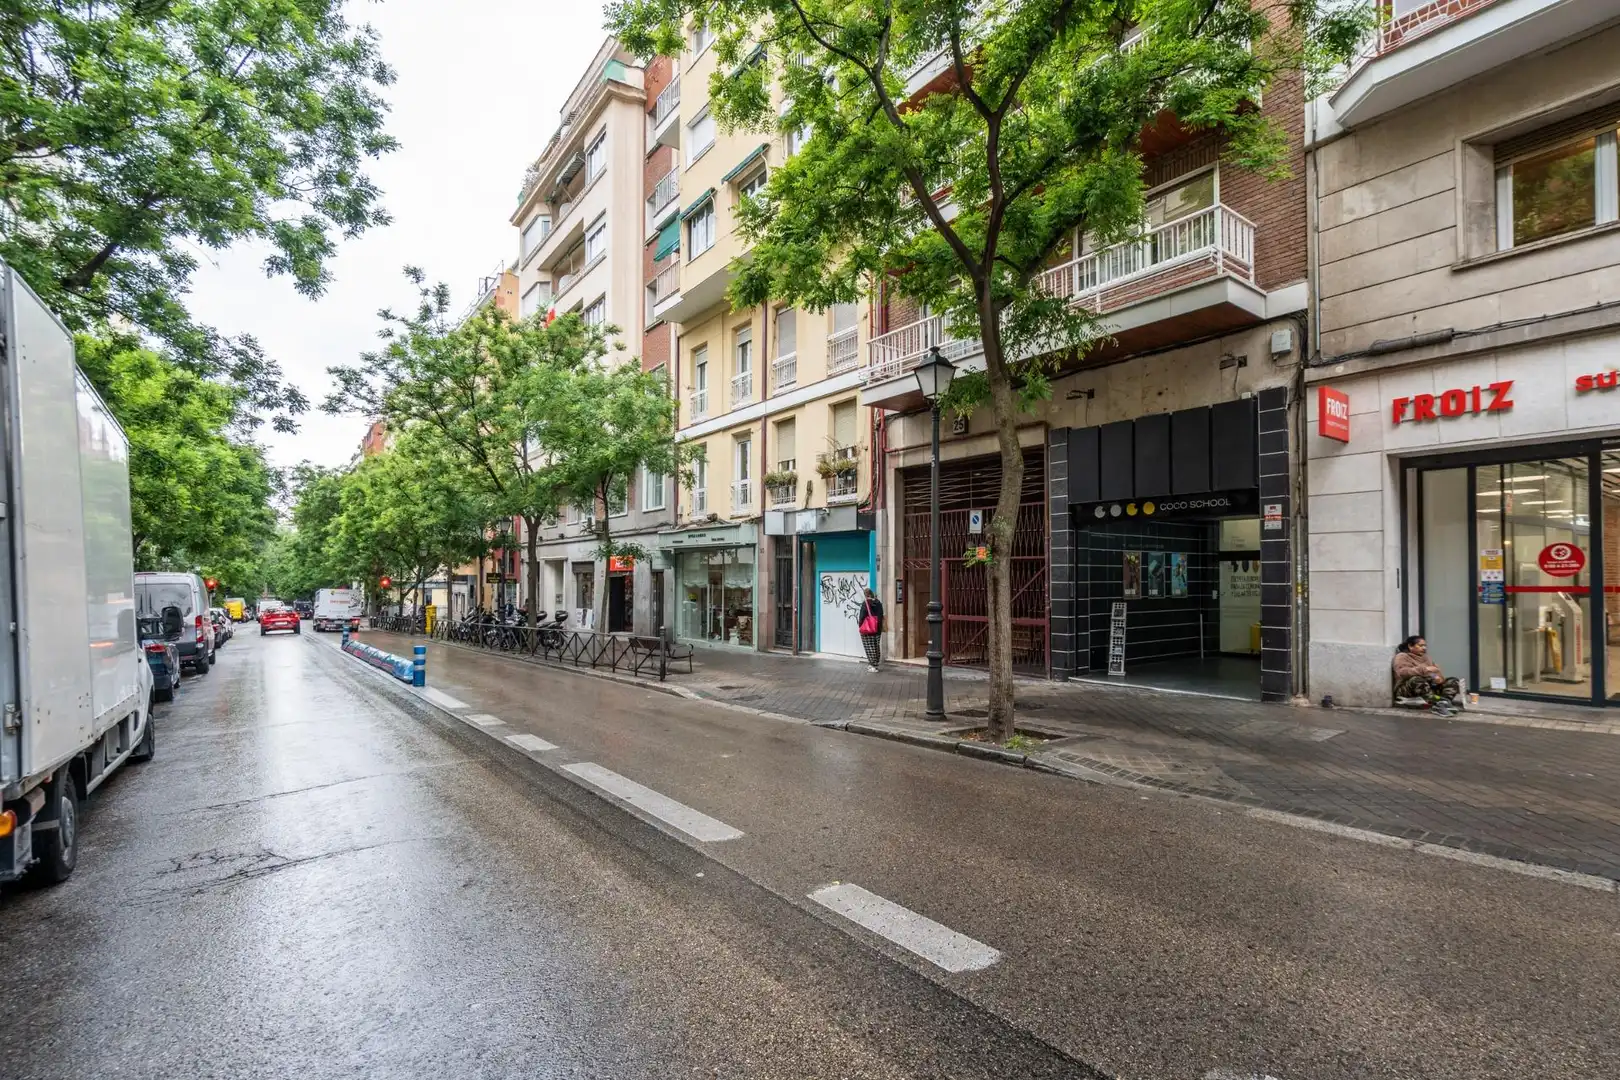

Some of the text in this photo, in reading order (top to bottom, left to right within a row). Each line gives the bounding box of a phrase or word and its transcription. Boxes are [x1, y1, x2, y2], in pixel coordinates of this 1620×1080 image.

[1575, 369, 1617, 391] su
[1326, 397, 1348, 420] FROIZ
[1392, 380, 1515, 424] FROIZ
[953, 416, 964, 431] 25
[1160, 498, 1232, 511] COCO SCHOOL
